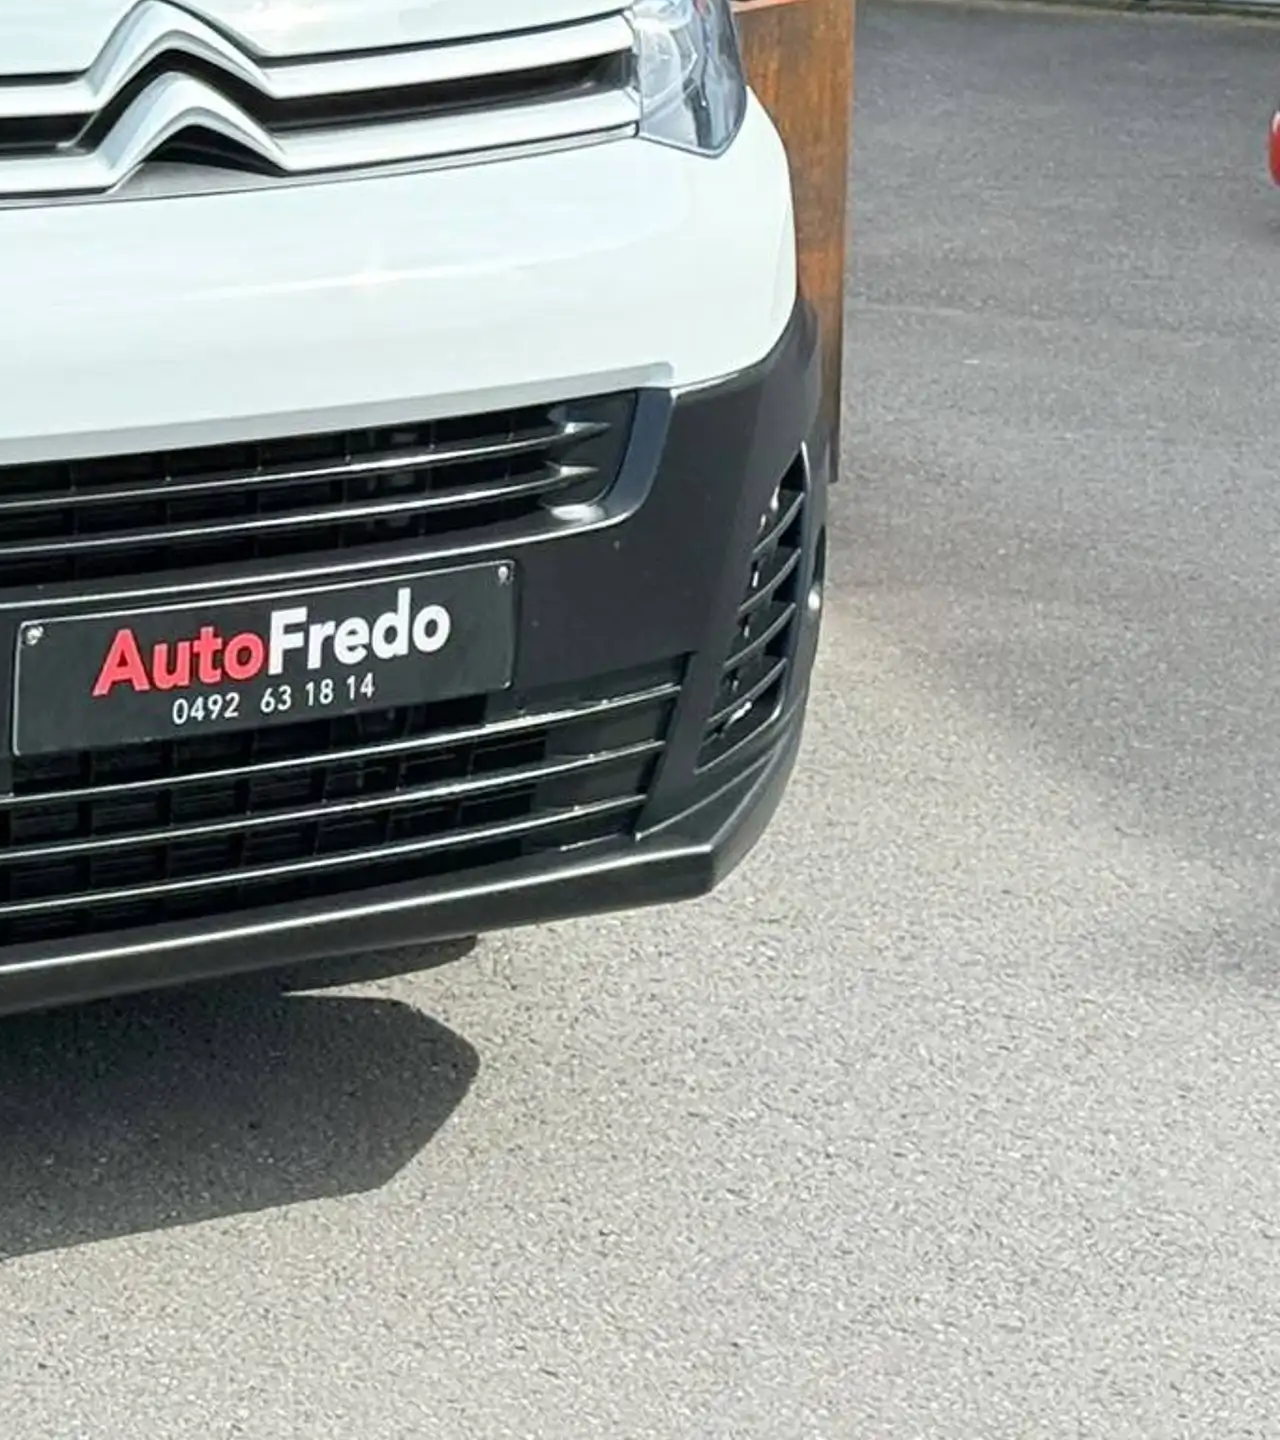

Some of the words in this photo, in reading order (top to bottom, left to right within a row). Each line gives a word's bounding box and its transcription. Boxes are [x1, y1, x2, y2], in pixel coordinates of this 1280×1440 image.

[92, 587, 452, 697] AutoFredo
[172, 691, 240, 725] 0492
[260, 684, 292, 713] 63
[304, 677, 334, 707] 18
[346, 672, 376, 702] 14
